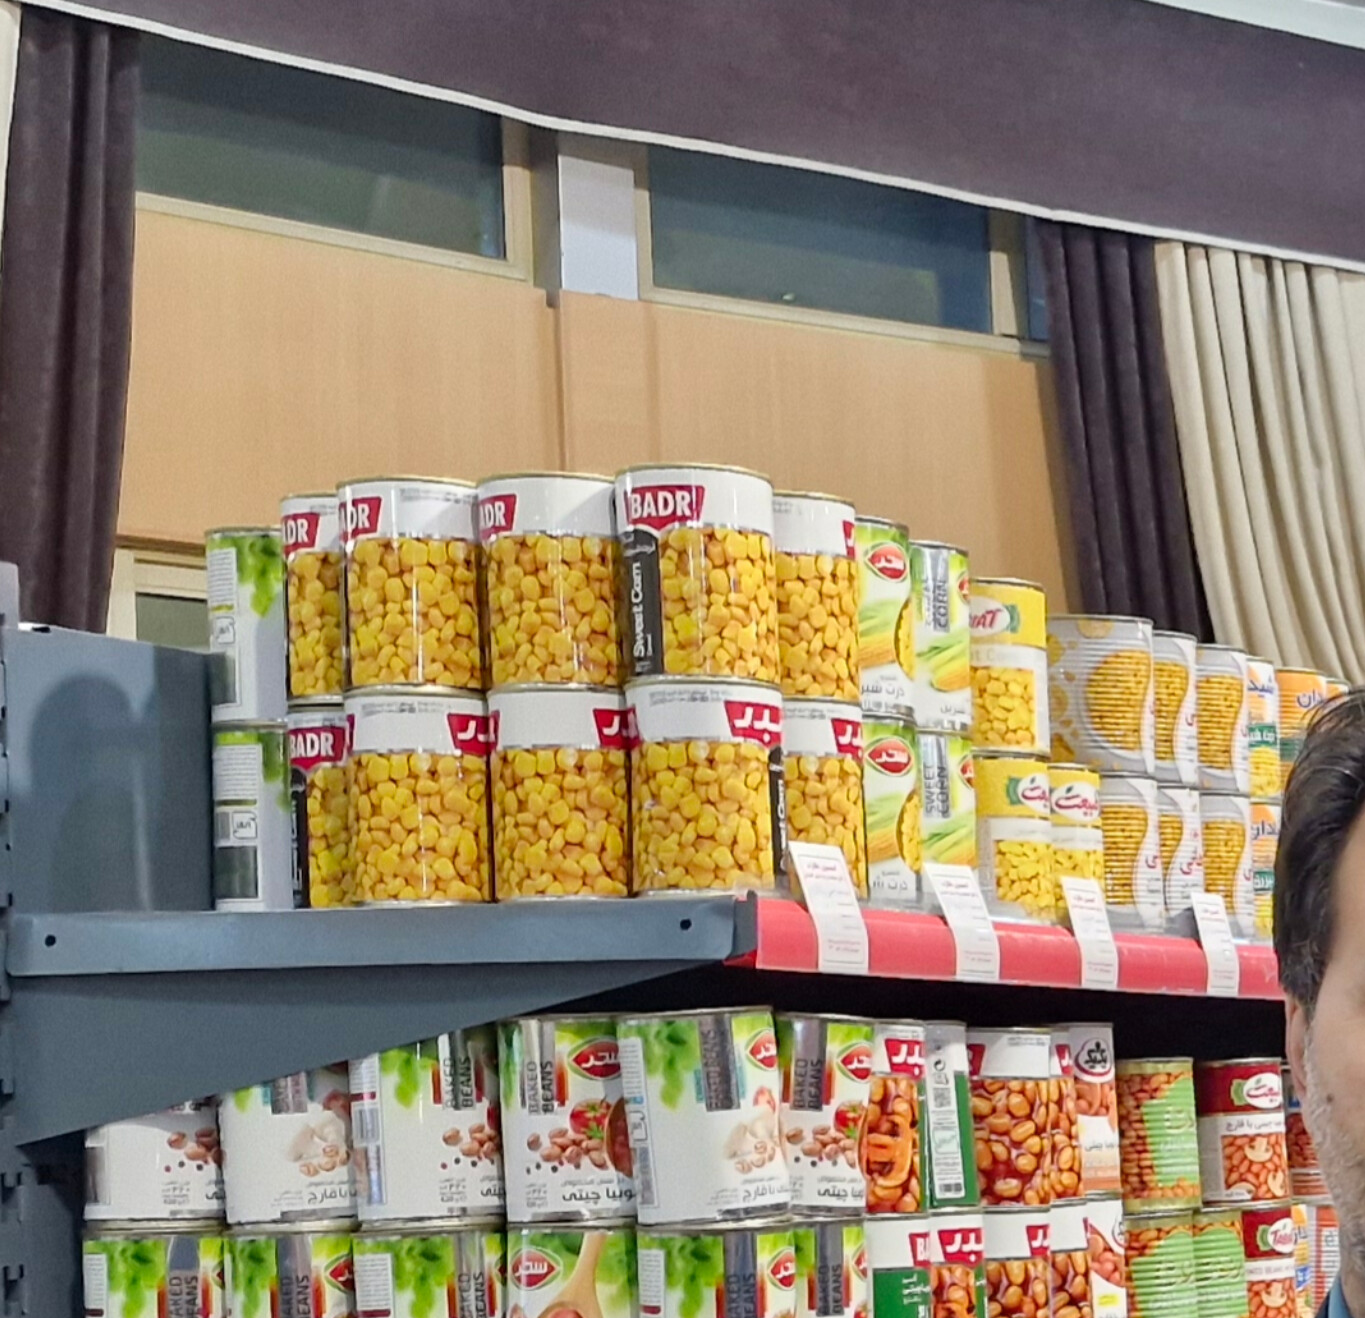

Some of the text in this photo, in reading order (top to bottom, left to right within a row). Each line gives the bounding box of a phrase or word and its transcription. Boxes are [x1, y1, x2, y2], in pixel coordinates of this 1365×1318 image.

[629, 490, 692, 518] BADR
[631, 561, 646, 657] Sweet Corn
[605, 1187, 637, 1202] وبیا
